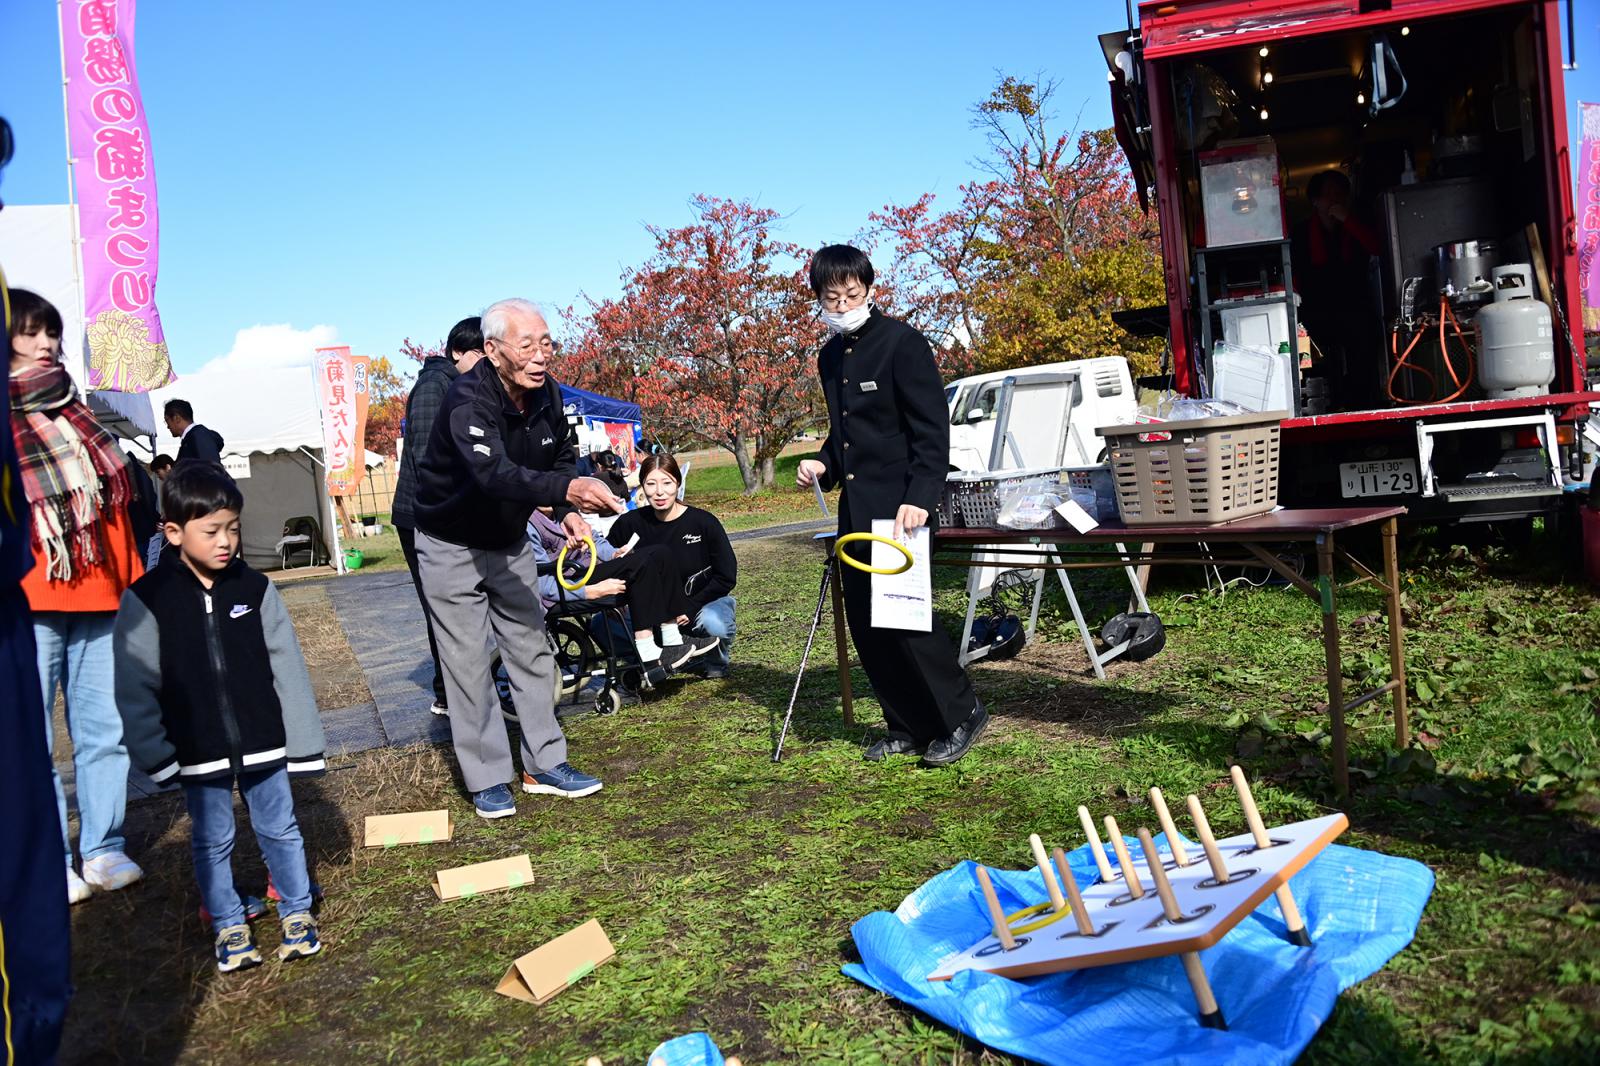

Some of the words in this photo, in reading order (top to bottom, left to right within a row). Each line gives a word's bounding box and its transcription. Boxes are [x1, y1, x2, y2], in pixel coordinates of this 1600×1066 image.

[1357, 463, 1379, 474] 山形
[1381, 461, 1400, 472] 130
[1360, 472, 1414, 494] 11-29
